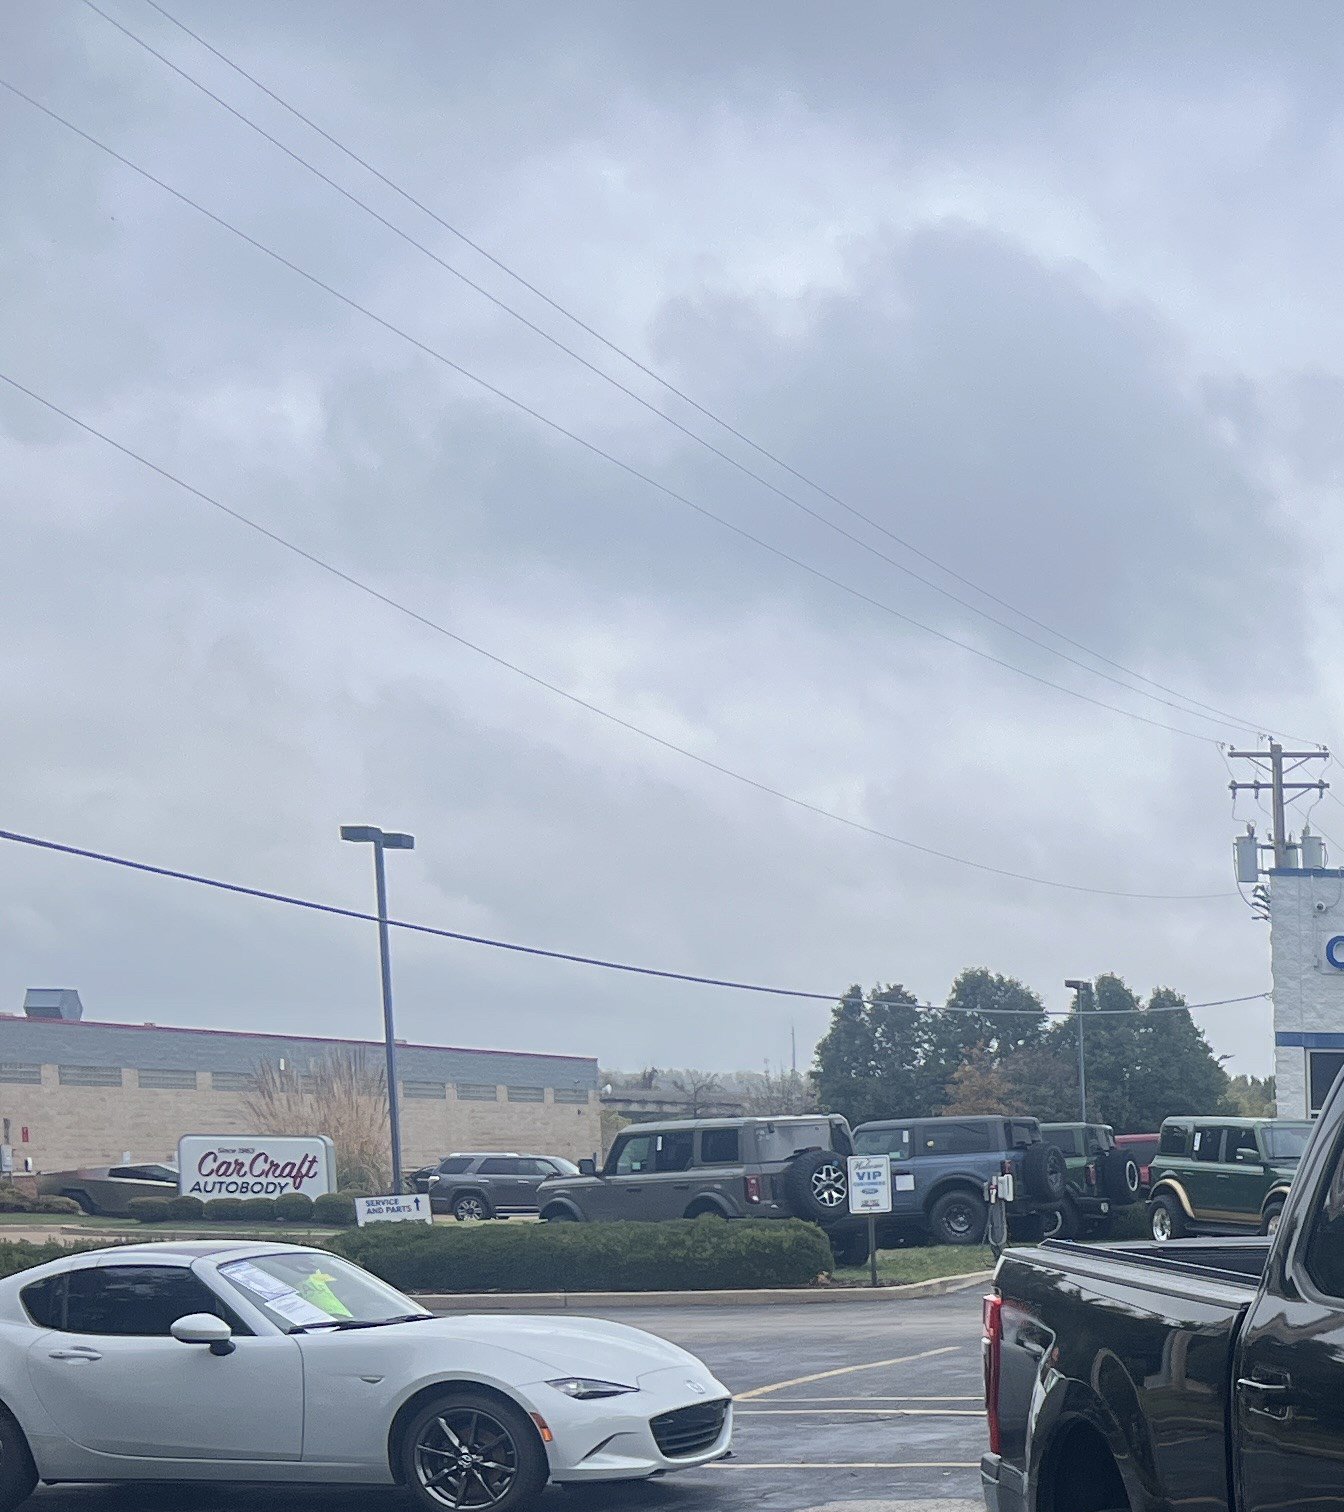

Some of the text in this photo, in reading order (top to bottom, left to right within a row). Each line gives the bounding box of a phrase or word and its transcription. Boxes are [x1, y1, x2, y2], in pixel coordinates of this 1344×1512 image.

[198, 1151, 319, 1190] Car Craft
[855, 1171, 882, 1181] VIP
[189, 1181, 290, 1195] AUTOBODY
[365, 1198, 400, 1207] SERVICE
[366, 1205, 412, 1215] AND PARTS
